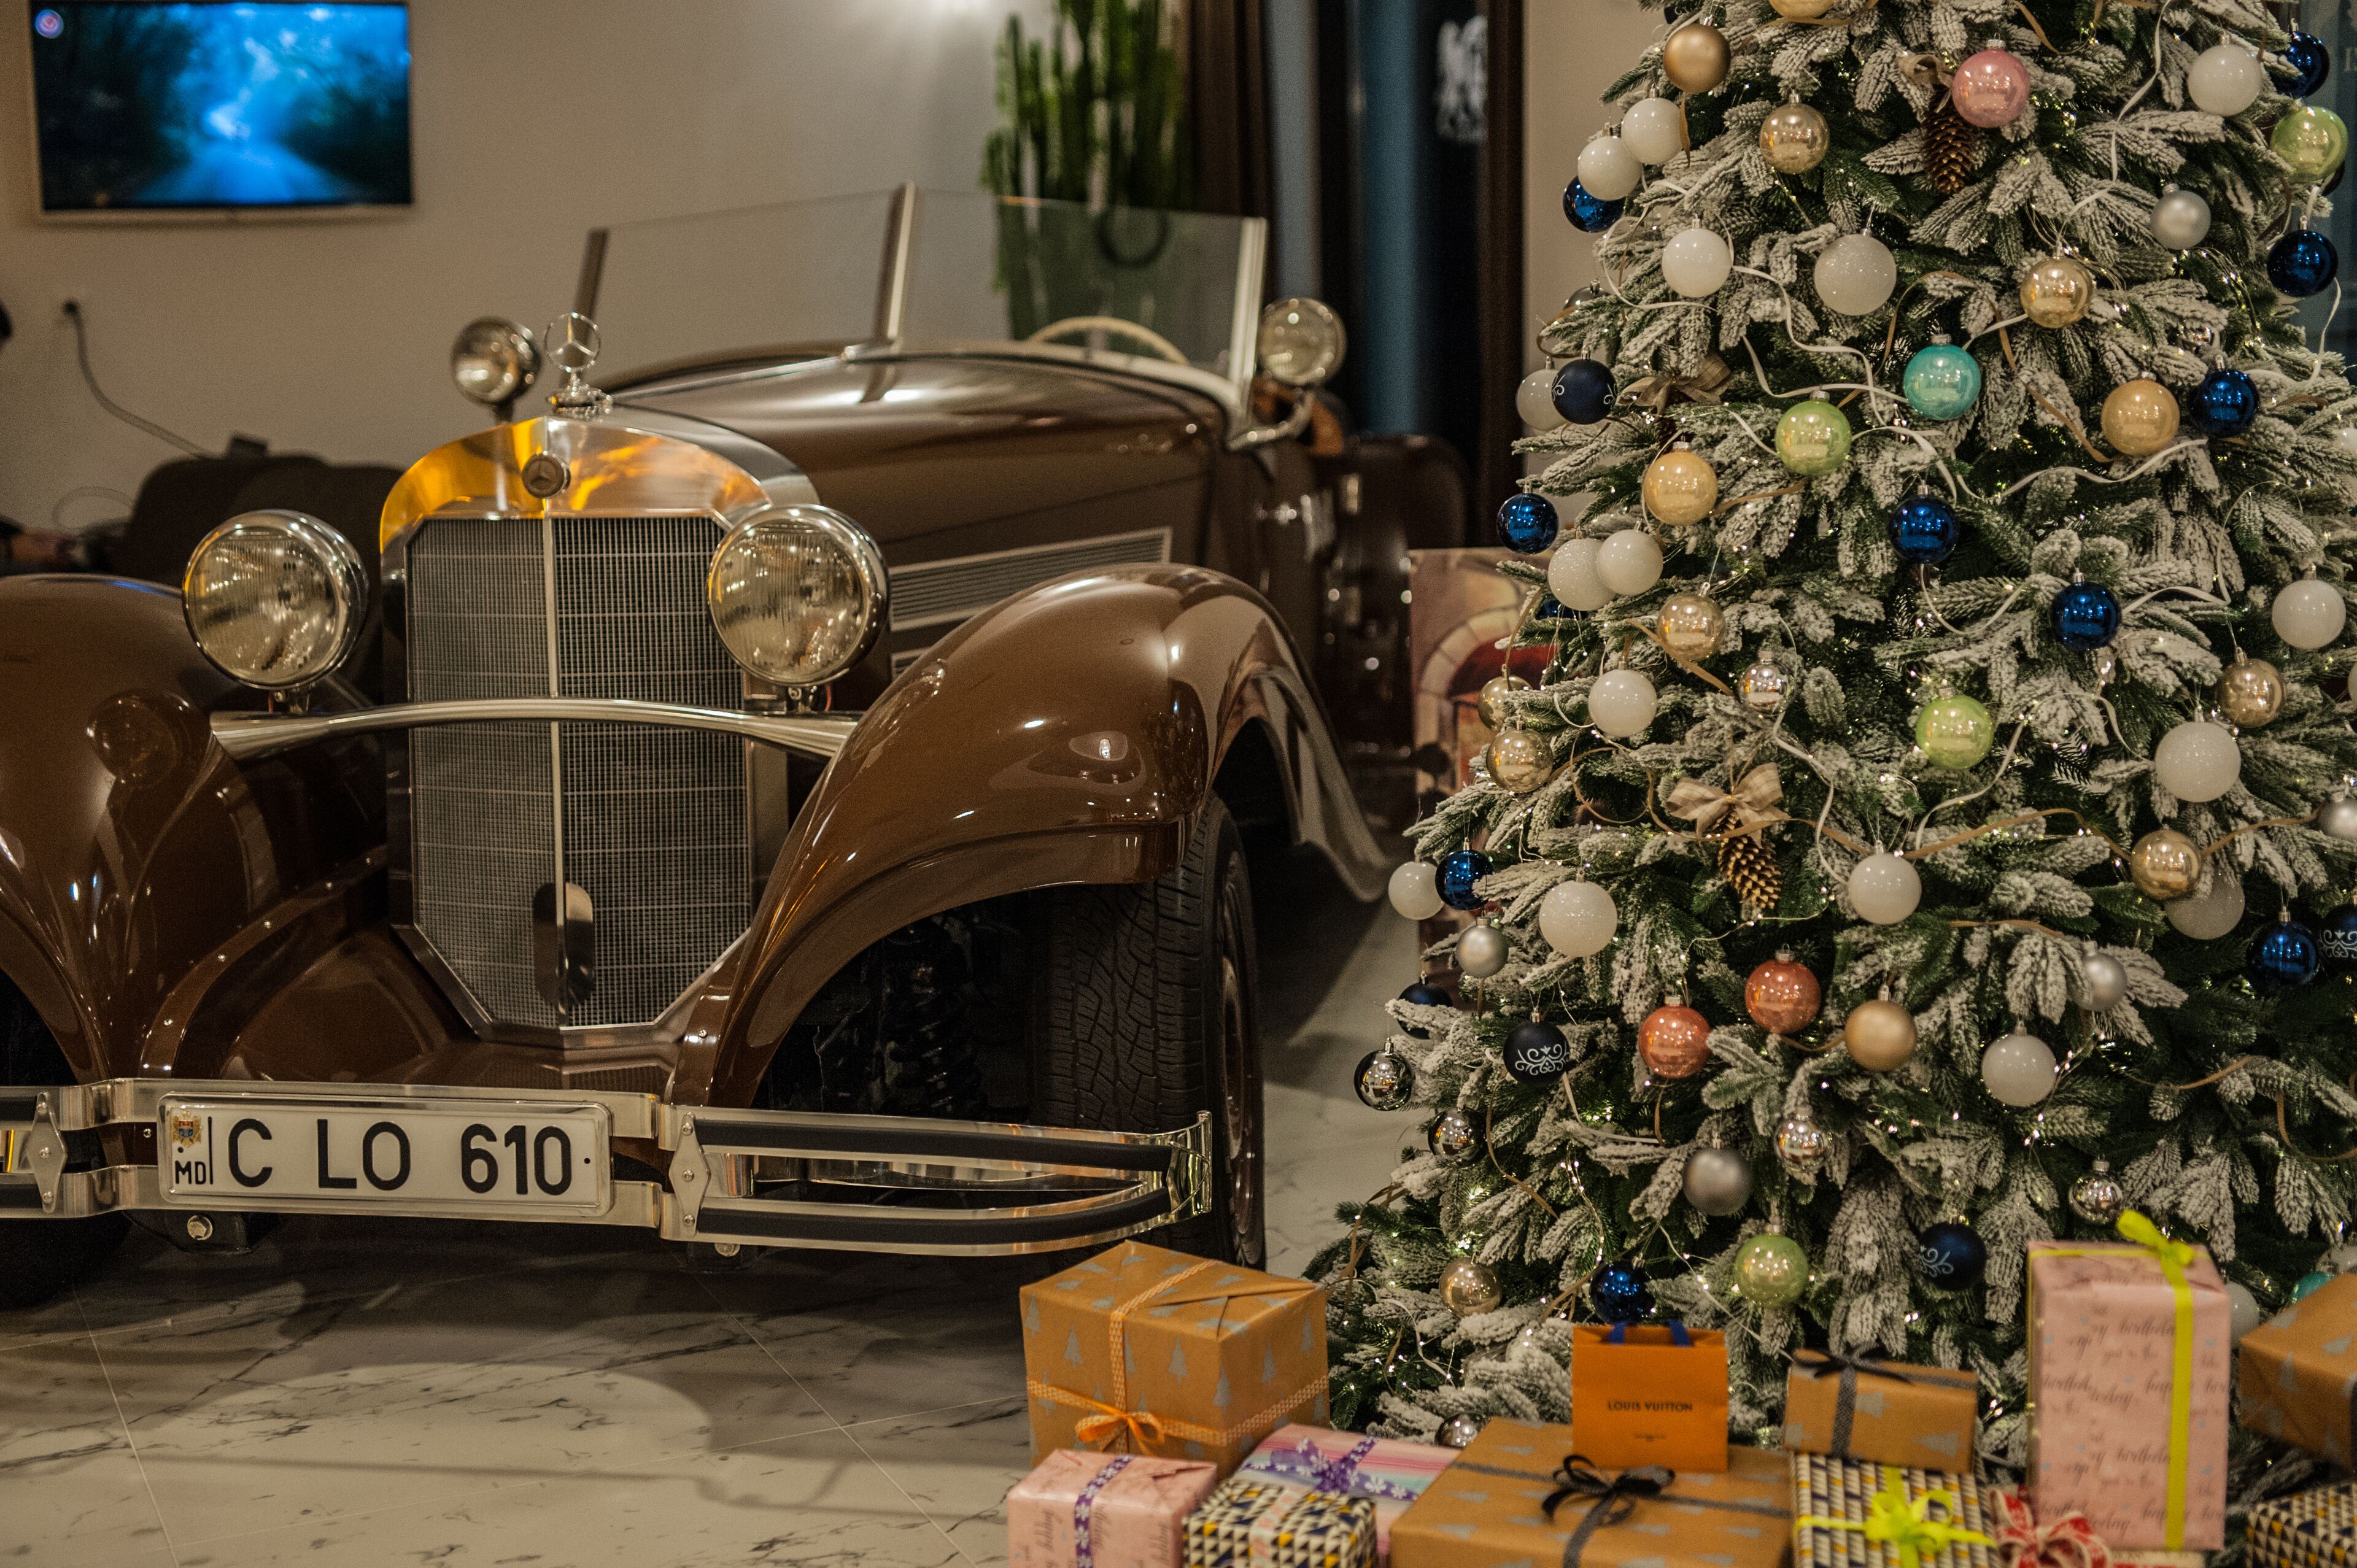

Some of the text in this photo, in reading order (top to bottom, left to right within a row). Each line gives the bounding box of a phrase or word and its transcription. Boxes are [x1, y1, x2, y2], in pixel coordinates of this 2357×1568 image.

[228, 1118, 572, 1196] C LO 610
[174, 1159, 207, 1185] MD
[1607, 1400, 1693, 1412] LOUIS VUITTON
